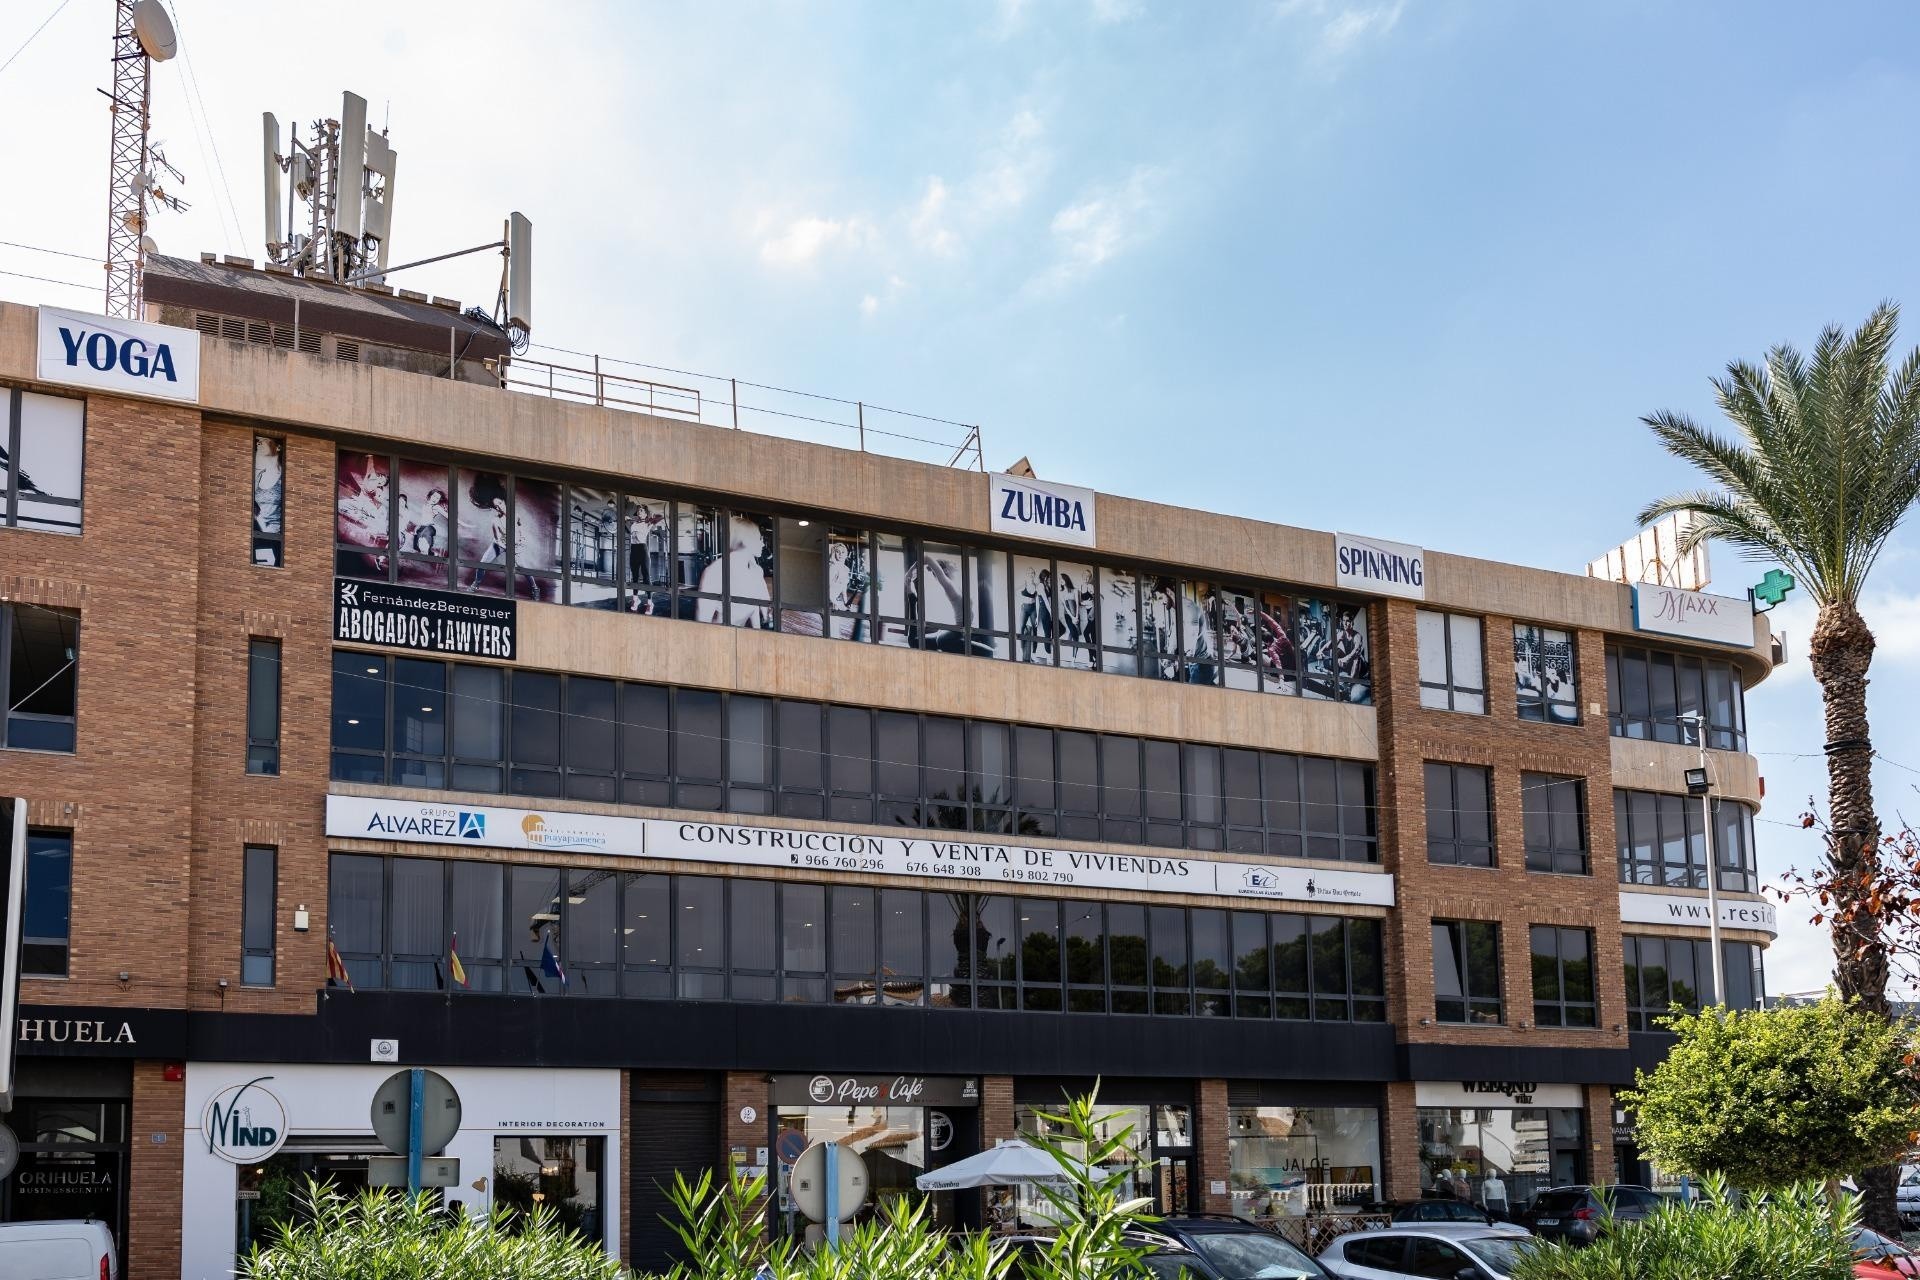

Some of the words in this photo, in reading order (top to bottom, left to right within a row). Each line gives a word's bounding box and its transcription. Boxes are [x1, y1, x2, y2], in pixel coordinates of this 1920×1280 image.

[58, 327, 177, 382] YOGA
[1001, 488, 1086, 531] ZUMBA
[1339, 546, 1422, 587] SPINNING
[366, 812, 457, 837] ALVAREZ
[420, 808, 456, 818] GRUPO
[679, 824, 884, 856] CONSTRUCCIÓN
[898, 841, 915, 857] Y
[931, 843, 1010, 864] VENTA
[1024, 849, 1054, 867] DE
[1068, 853, 1190, 877] VIVIENDAS
[805, 855, 829, 866] 966
[834, 857, 857, 868] 760
[861, 858, 884, 870] 296
[906, 862, 929, 873] 676
[933, 864, 955, 875] 648
[960, 865, 981, 876] 308
[1002, 868, 1024, 880] 619
[1028, 870, 1048, 881] 802
[1052, 872, 1074, 883] 790
[889, 1076, 924, 1103] Café
[19, 1171, 112, 1185] ORIHUELA
